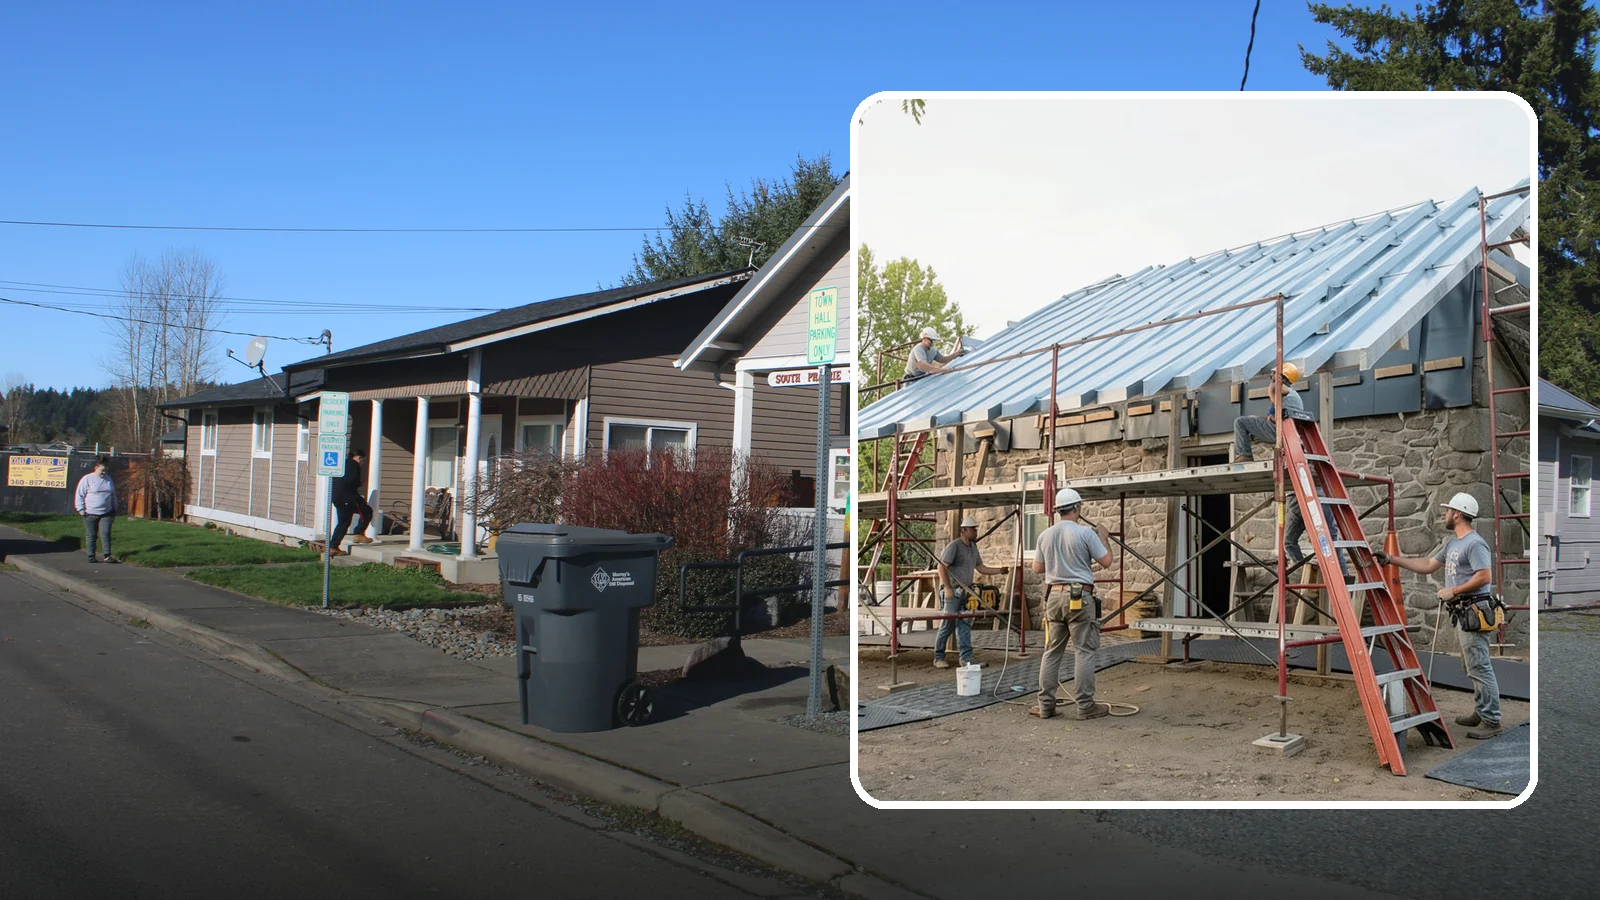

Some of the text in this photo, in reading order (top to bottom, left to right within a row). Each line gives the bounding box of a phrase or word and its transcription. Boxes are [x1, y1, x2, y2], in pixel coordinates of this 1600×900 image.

[815, 295, 833, 308] TOWN
[814, 312, 831, 325] HALL
[810, 326, 836, 341] PARKING
[814, 344, 831, 357] ONLY
[775, 373, 801, 384] SOUTH
[808, 370, 842, 382] PRIE
